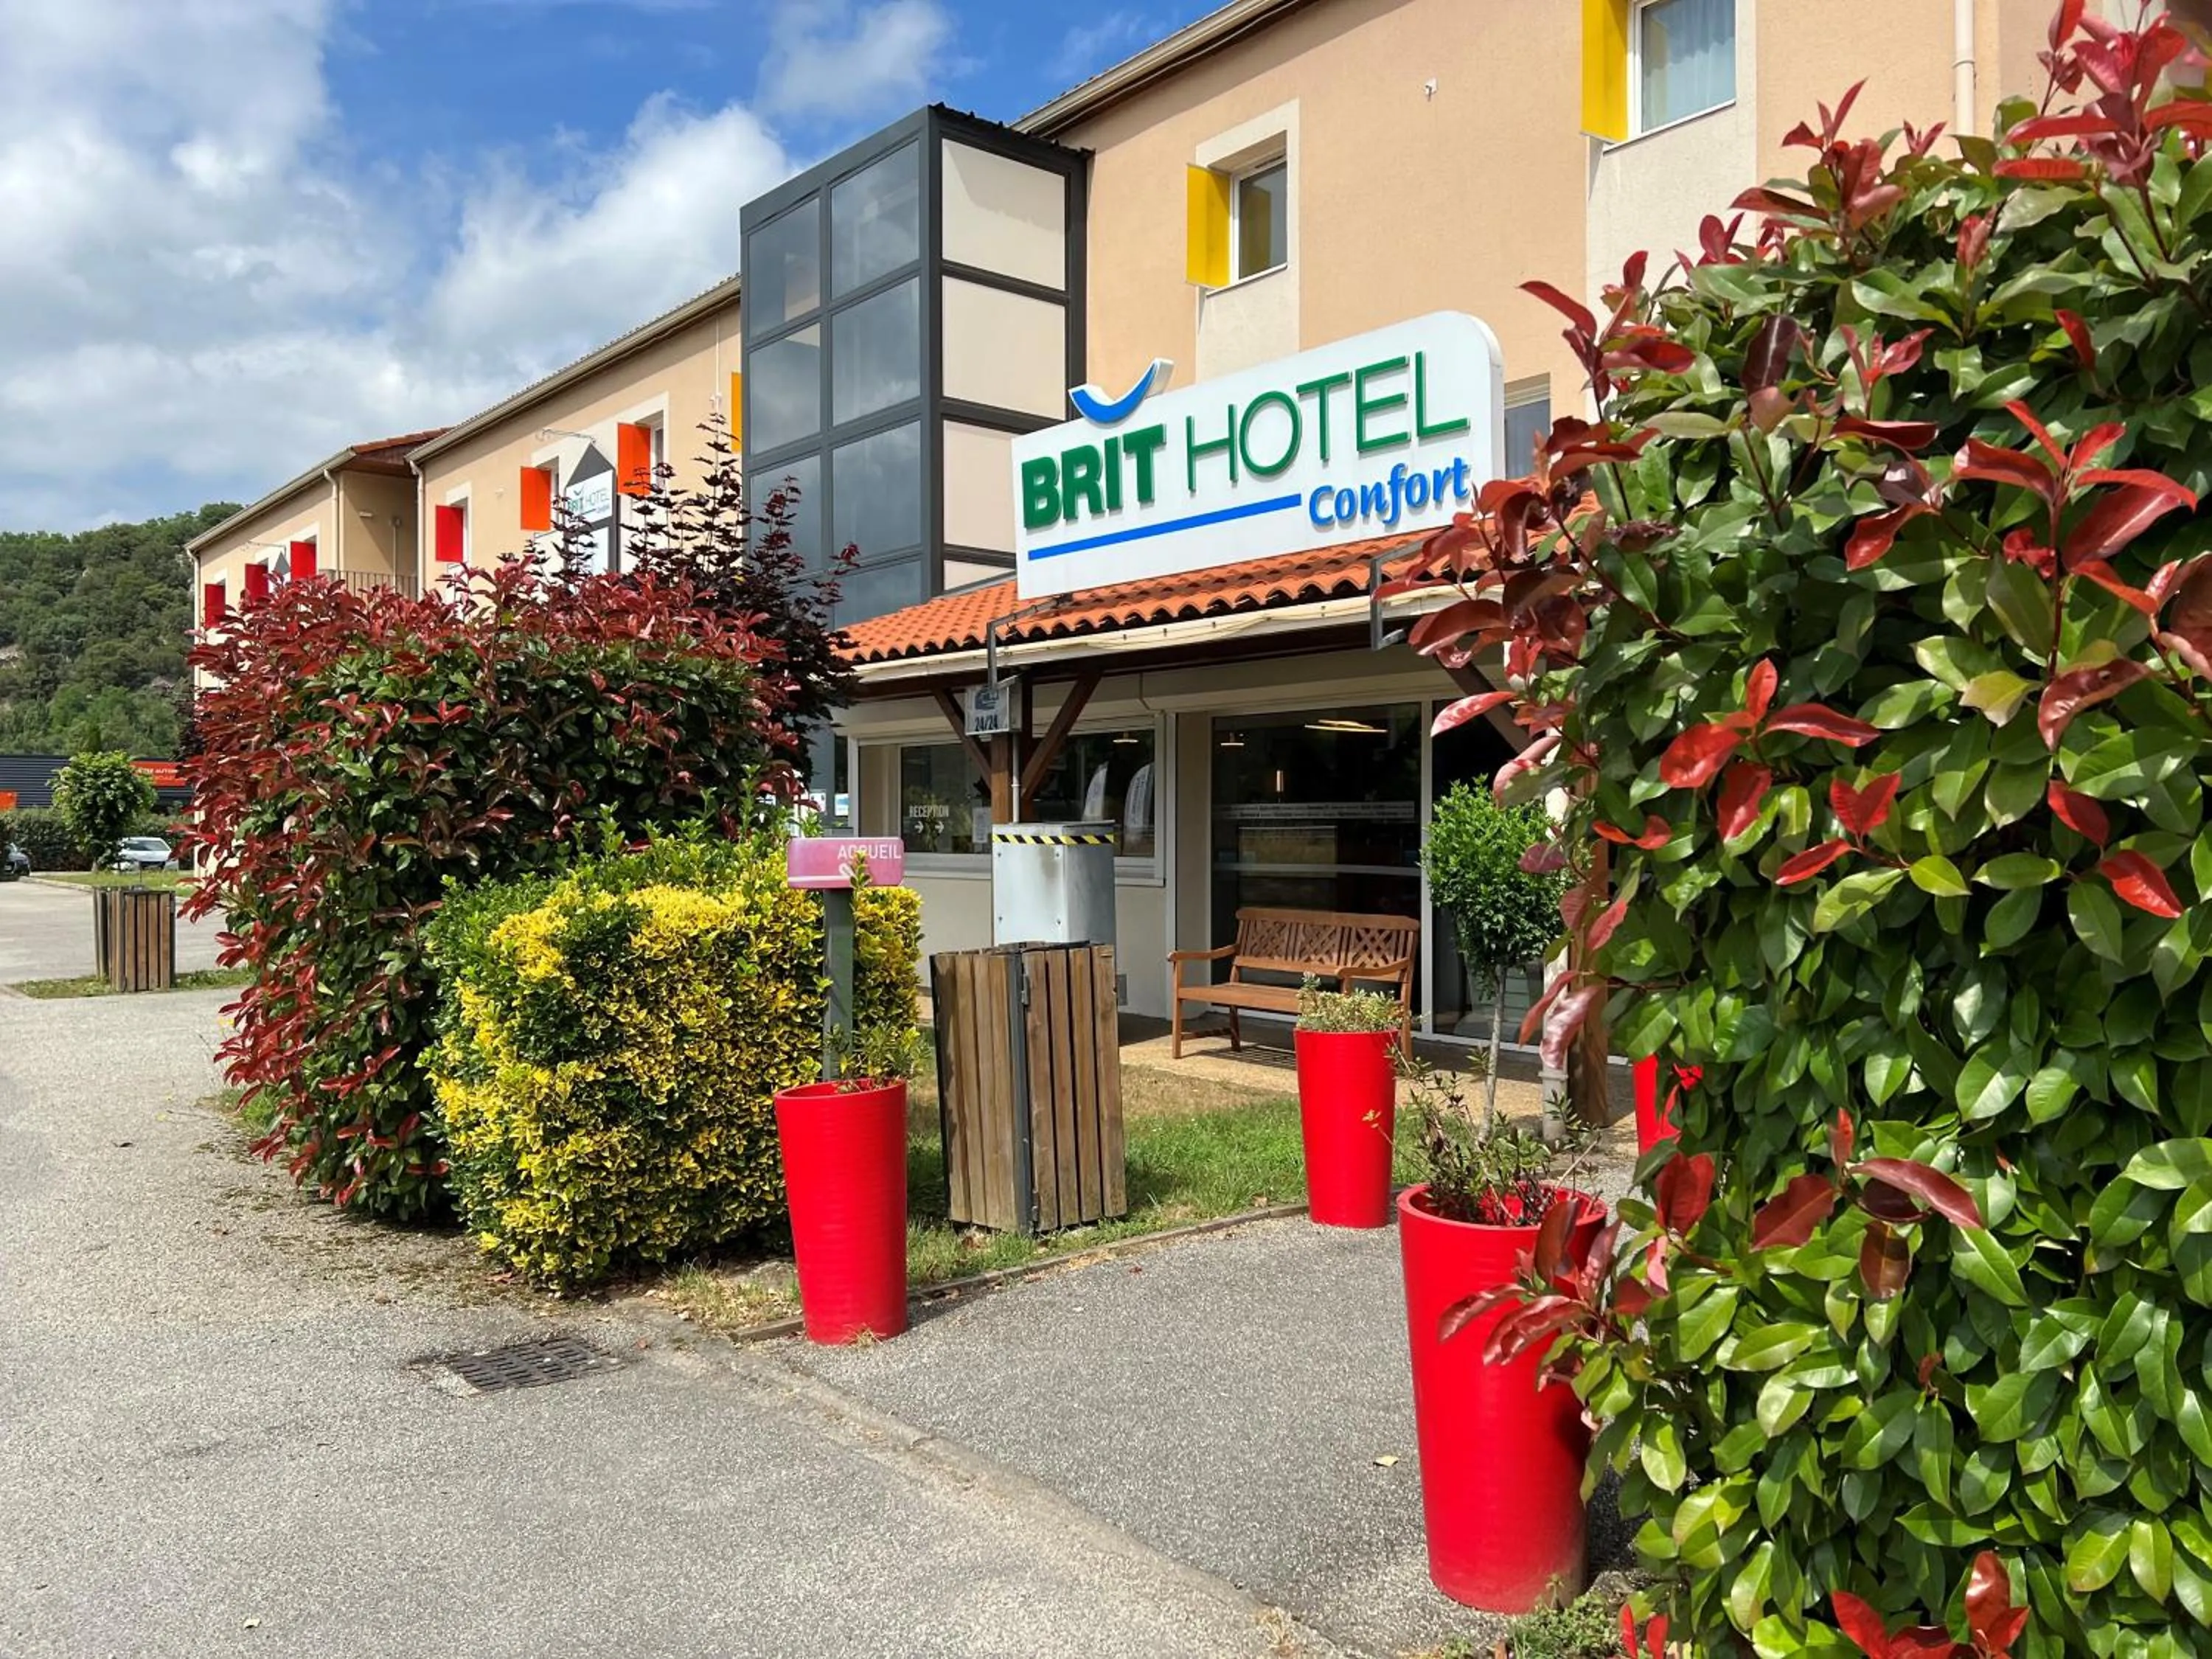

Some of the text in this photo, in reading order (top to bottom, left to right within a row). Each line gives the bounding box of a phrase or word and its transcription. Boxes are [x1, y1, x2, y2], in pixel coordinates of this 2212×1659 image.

[1022, 352, 1470, 529] BRIT HOTEL
[585, 488, 610, 508] HOTEL
[1310, 457, 1467, 525] Confort
[975, 714, 998, 731] 24/24
